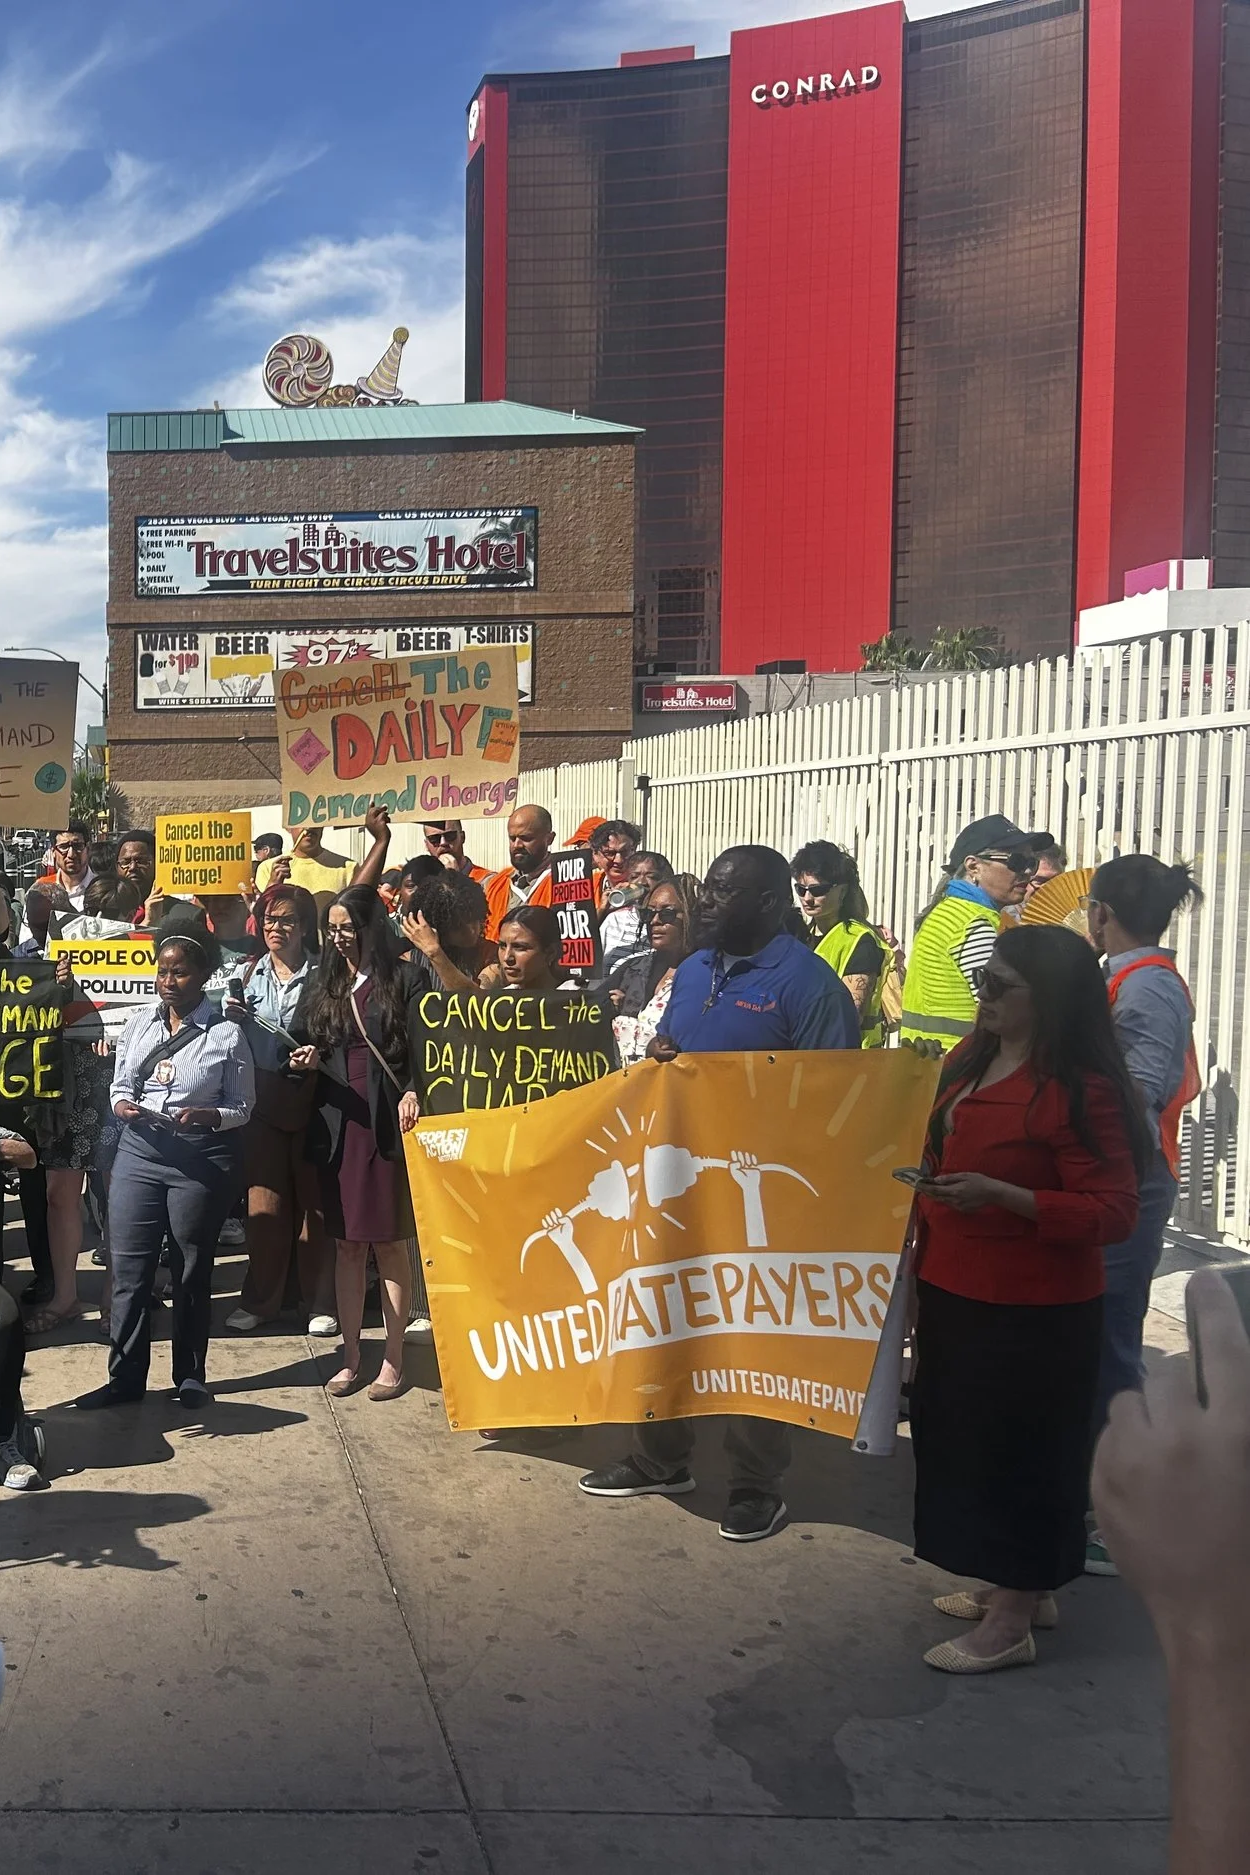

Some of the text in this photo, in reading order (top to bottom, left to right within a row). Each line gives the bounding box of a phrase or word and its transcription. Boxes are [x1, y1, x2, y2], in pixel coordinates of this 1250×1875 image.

[751, 65, 878, 103] CONRAD
[187, 517, 213, 525] VEGAS
[216, 516, 236, 524] BLVD
[378, 511, 402, 519] CALL
[404, 511, 417, 519] US
[164, 529, 197, 537] PARKING
[146, 540, 184, 548] FREE WI-FI
[146, 551, 165, 559] POOL
[187, 531, 527, 577] Travelsuites Hotel
[146, 565, 166, 573] DAILY
[146, 586, 180, 594] MONTHLY
[250, 575, 468, 589] TURN RIGHT ON CIRCUS CIRCUS DRIVE
[141, 633, 199, 652] WATER
[397, 632, 451, 651] BEER
[464, 625, 528, 644] T-SHIRTS
[215, 635, 269, 655] BEER
[155, 660, 167, 668] for
[410, 656, 492, 695] The
[14, 681, 49, 698] THE
[645, 696, 732, 707] Travelsuites Hotel
[288, 774, 518, 825] Demand Charge
[166, 820, 233, 842] Cancel the
[159, 842, 245, 865] Daily Demand
[172, 866, 222, 887] Charge!
[557, 858, 585, 882] YOUR
[554, 881, 589, 901] PROFITS
[557, 910, 591, 939] OUR
[131, 951, 158, 965] OV
[561, 941, 591, 963] PAIN
[81, 979, 158, 995] POLLUTE
[419, 992, 601, 1031] CANCEL the
[425, 1040, 610, 1085] DAILY DEMAND
[425, 1141, 461, 1158] ACTION
[469, 1262, 892, 1381] UNITED RATEPAYERS
